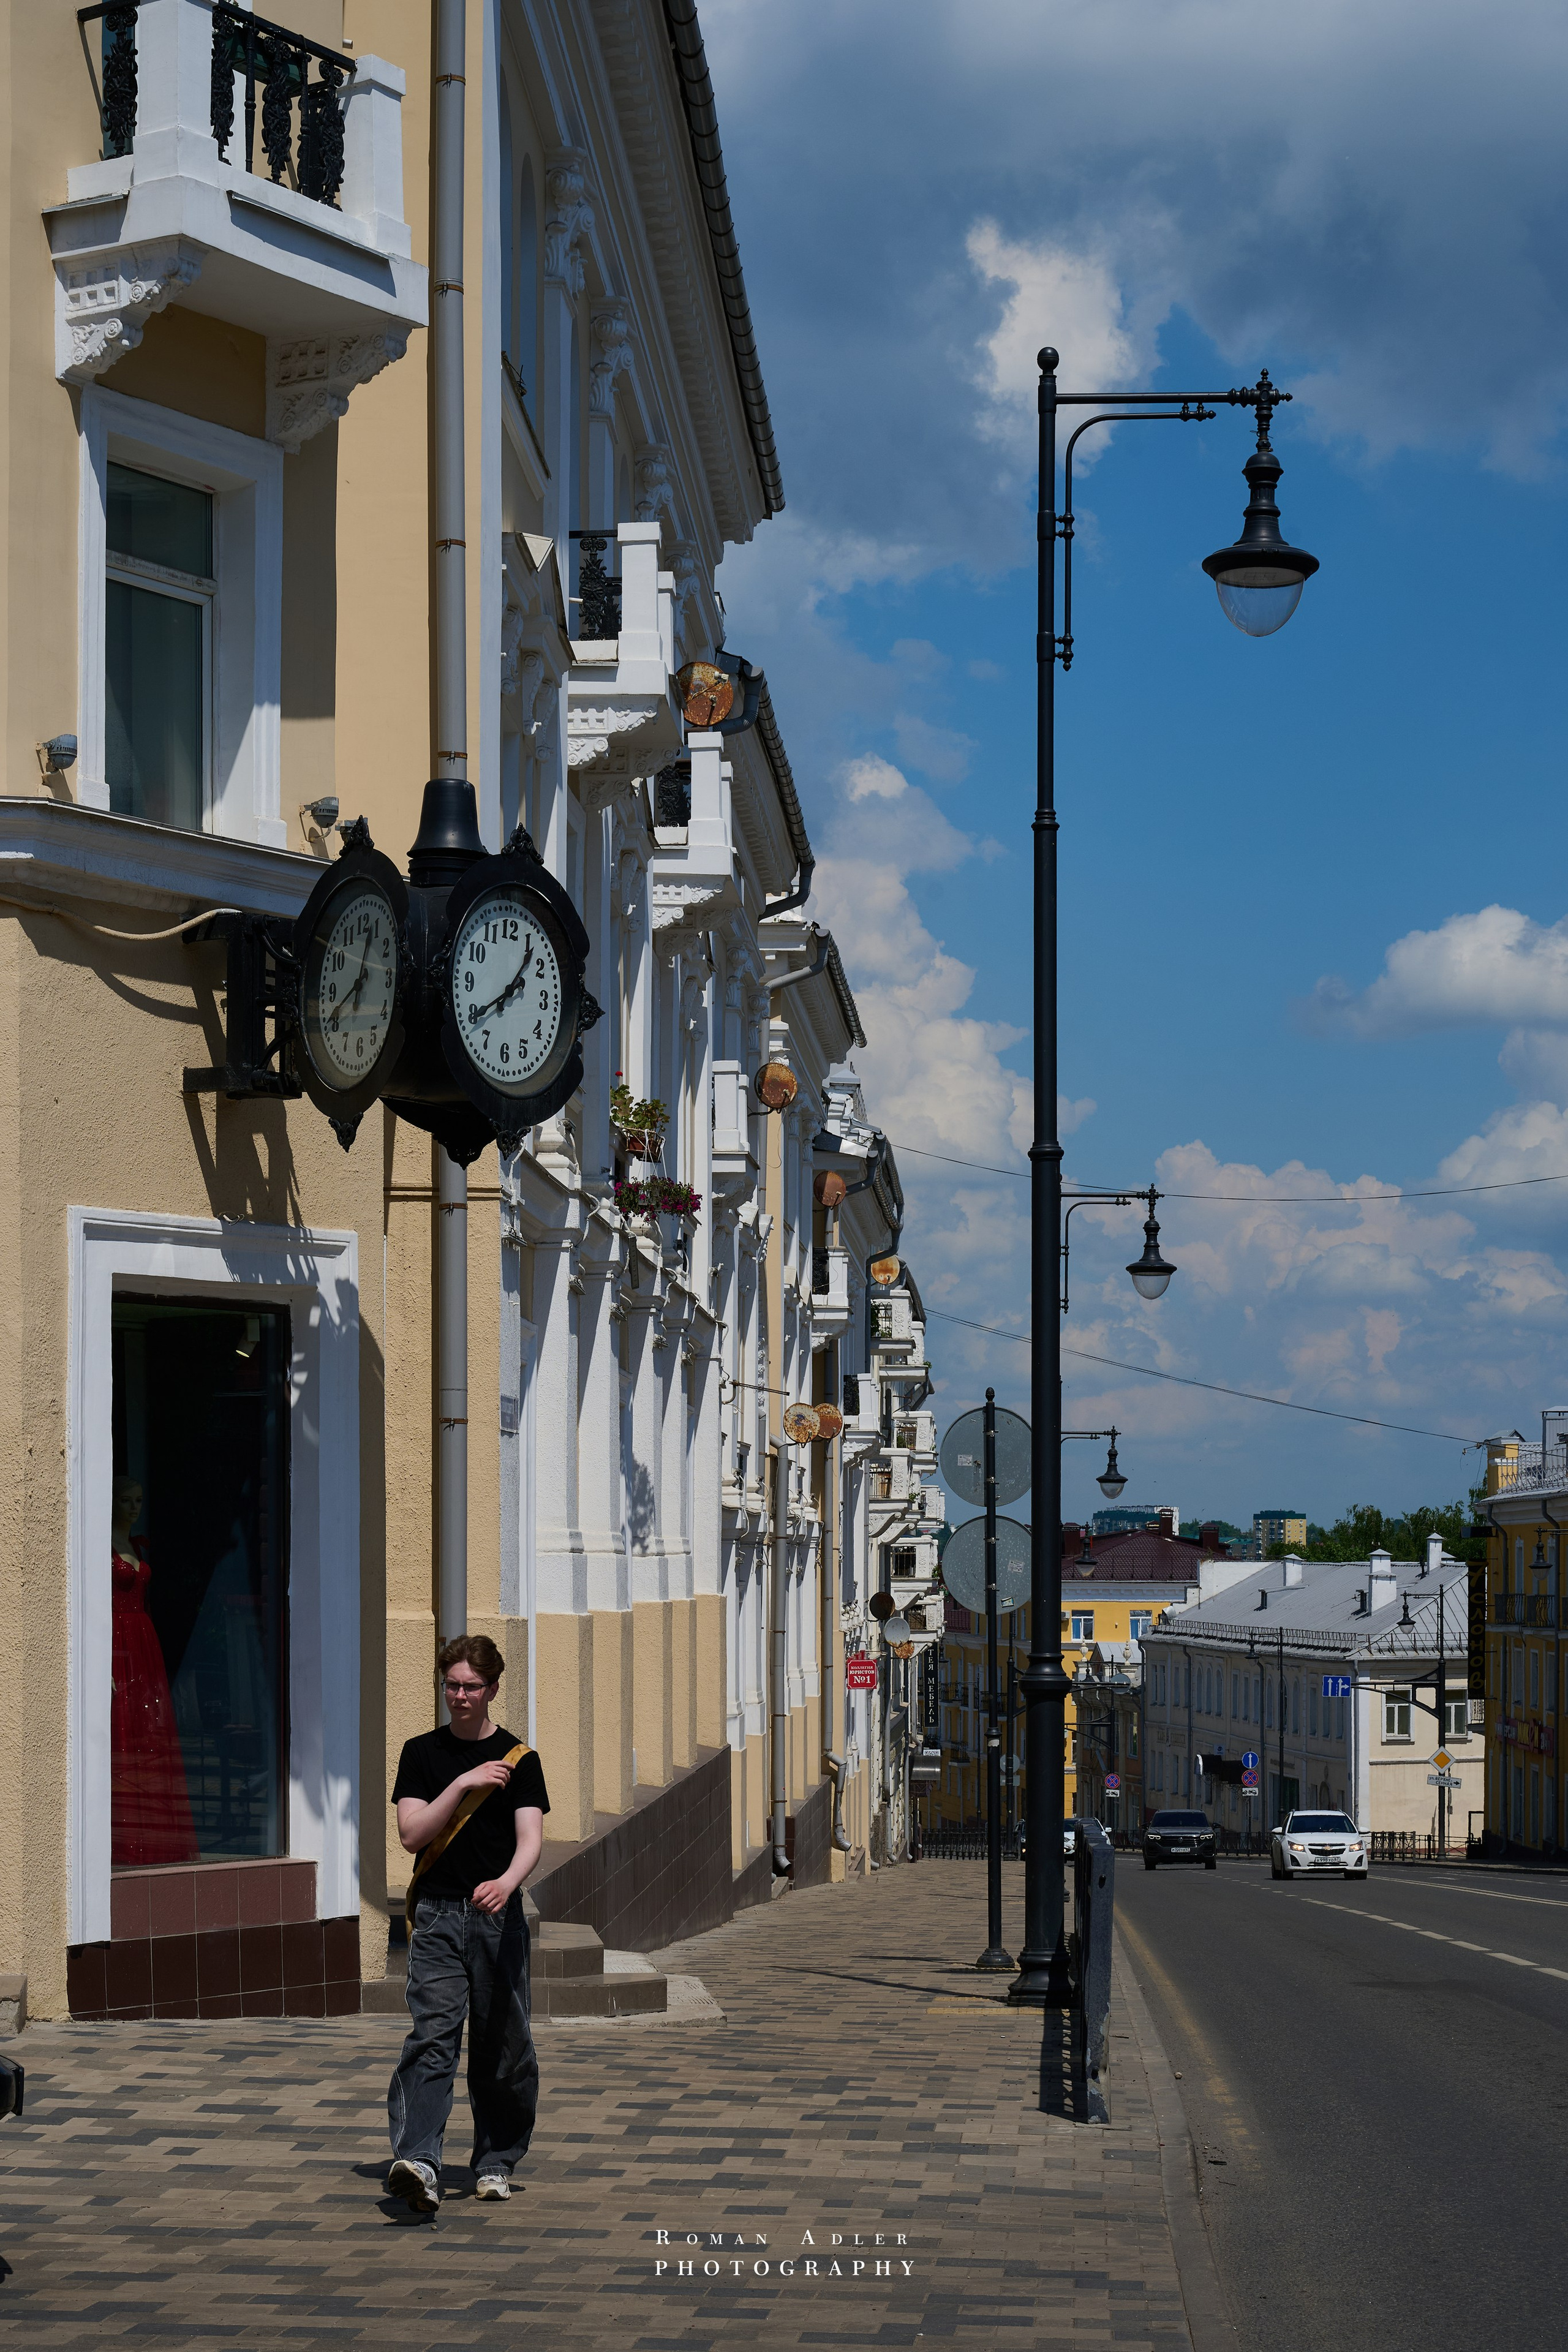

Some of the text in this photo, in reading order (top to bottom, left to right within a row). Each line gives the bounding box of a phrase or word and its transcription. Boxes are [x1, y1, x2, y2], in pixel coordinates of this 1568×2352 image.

[357, 913, 369, 935] 12
[375, 918, 379, 938] 1
[484, 922, 498, 944] 11
[501, 919, 518, 941] 12
[343, 924, 355, 947] 11
[526, 933, 531, 952] 1
[383, 938, 389, 958] 2
[469, 941, 486, 963] 10
[332, 950, 345, 972] 10
[536, 958, 545, 979] 2
[385, 967, 392, 988] 3
[465, 971, 475, 992] 9
[329, 982, 336, 1003] 9
[539, 990, 548, 1011] 3
[380, 1000, 388, 1020] 4
[468, 1004, 478, 1024] 8
[331, 1012, 339, 1032] 8
[533, 1019, 542, 1040] 4
[342, 1031, 349, 1052] 7
[370, 1024, 377, 1046] 5
[482, 1029, 490, 1050] 7
[356, 1037, 363, 1057] 6
[500, 1042, 510, 1063] 6
[519, 1038, 528, 1059] 5
[1466, 1561, 1489, 1588] 7
